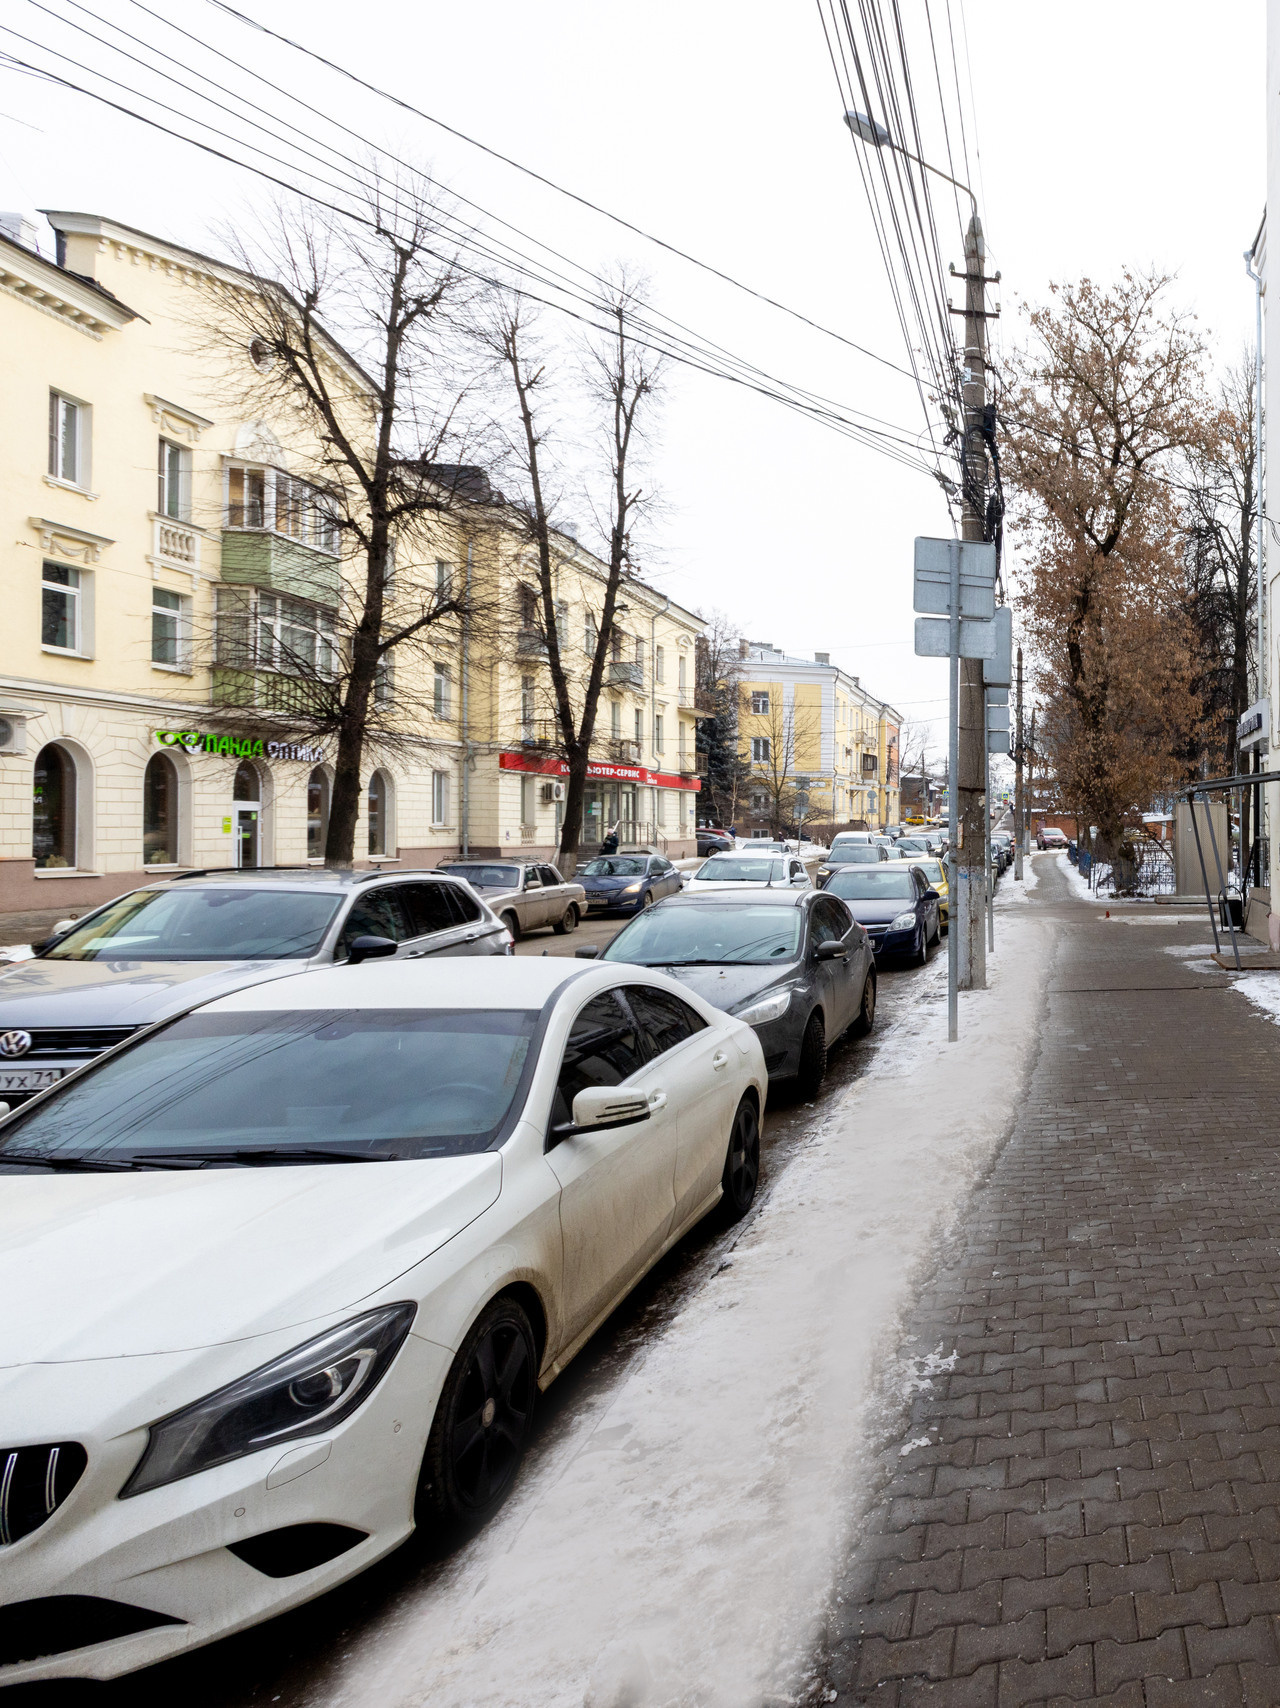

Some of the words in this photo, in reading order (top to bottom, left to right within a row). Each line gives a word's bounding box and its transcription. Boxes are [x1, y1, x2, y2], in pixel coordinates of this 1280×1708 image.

[205, 734, 264, 758] ПАНДА
[267, 741, 323, 762] ОПТИКА
[561, 764, 640, 778] КОЬЮТЕР-СЕРВИС
[34, 1071, 54, 1083] 71
